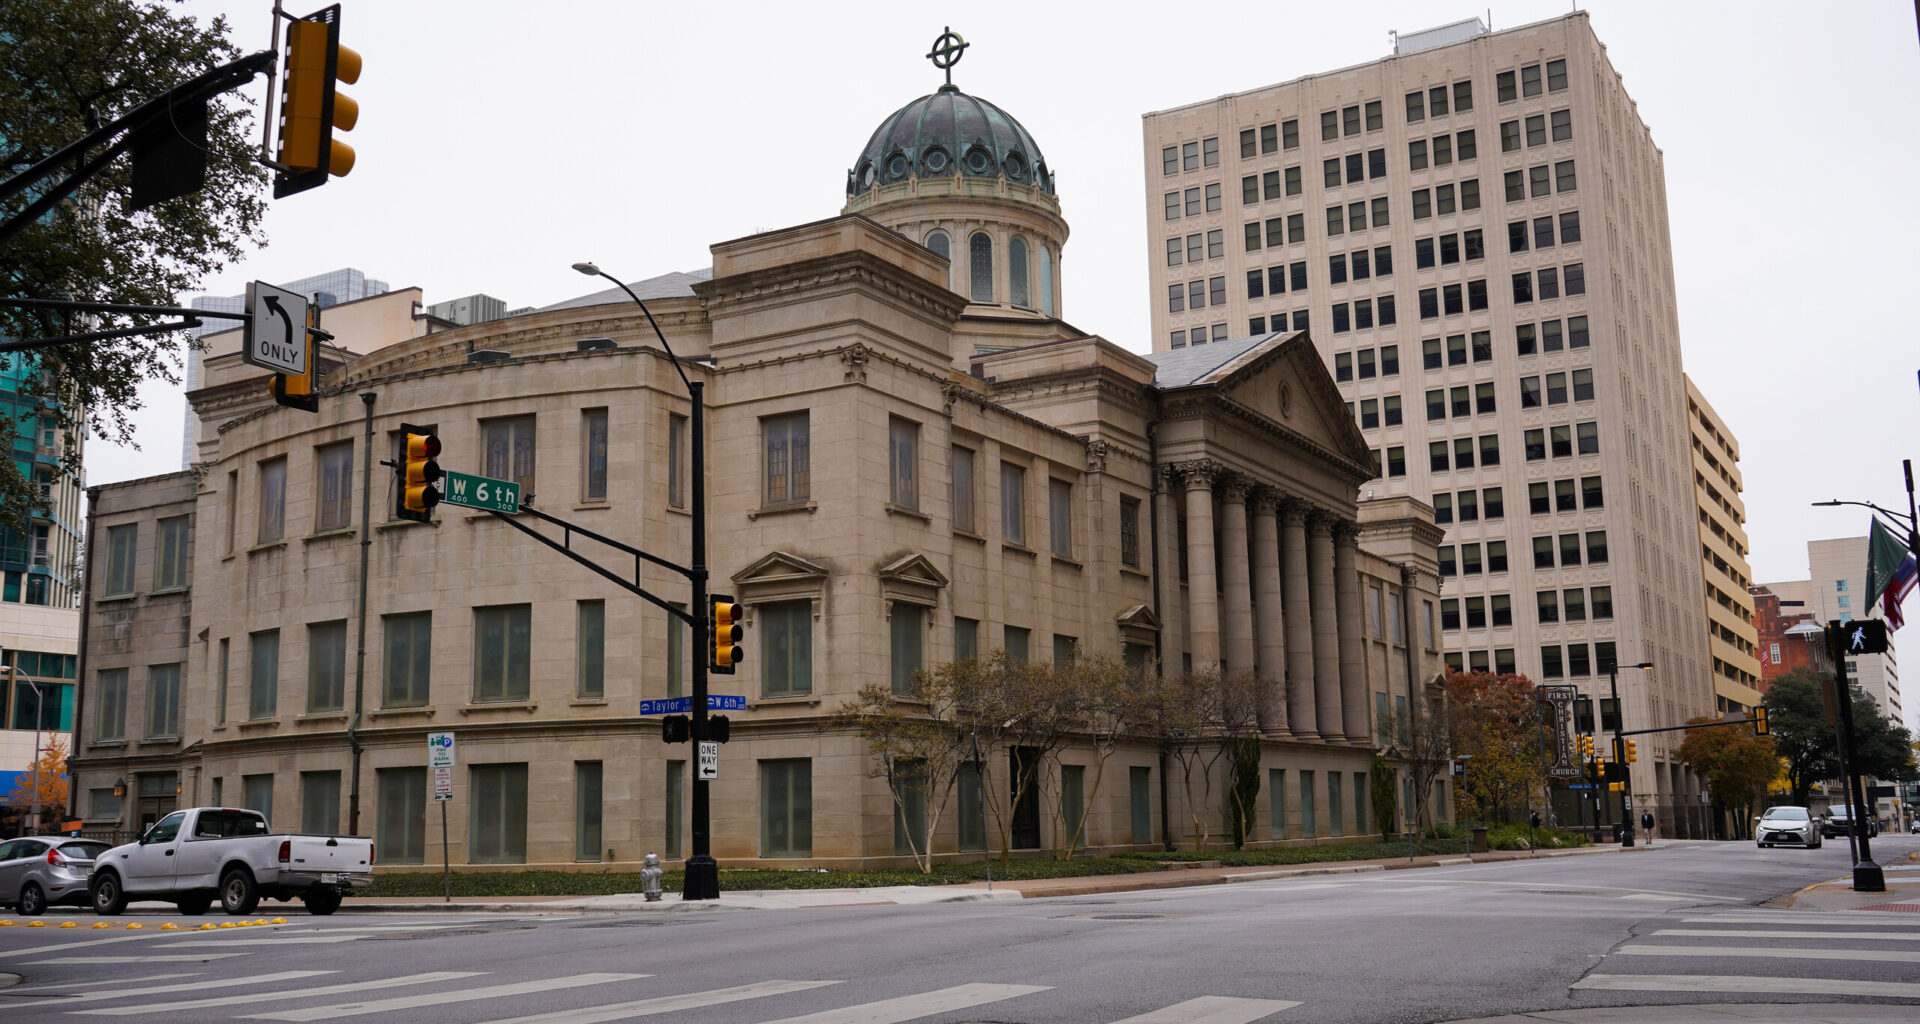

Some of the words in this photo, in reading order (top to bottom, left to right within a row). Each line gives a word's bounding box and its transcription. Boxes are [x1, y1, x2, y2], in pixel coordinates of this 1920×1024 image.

[261, 341, 298, 364] ONLY
[453, 478, 467, 495] W
[476, 482, 515, 504] 6th
[451, 494, 468, 503] 400
[497, 503, 513, 511] 300
[652, 700, 679, 712] Taylor
[715, 697, 721, 707] W
[724, 698, 737, 708] 6th
[1558, 701, 1568, 766] CHRISTIAN
[701, 745, 716, 755] ONE
[701, 756, 717, 765] WAY
